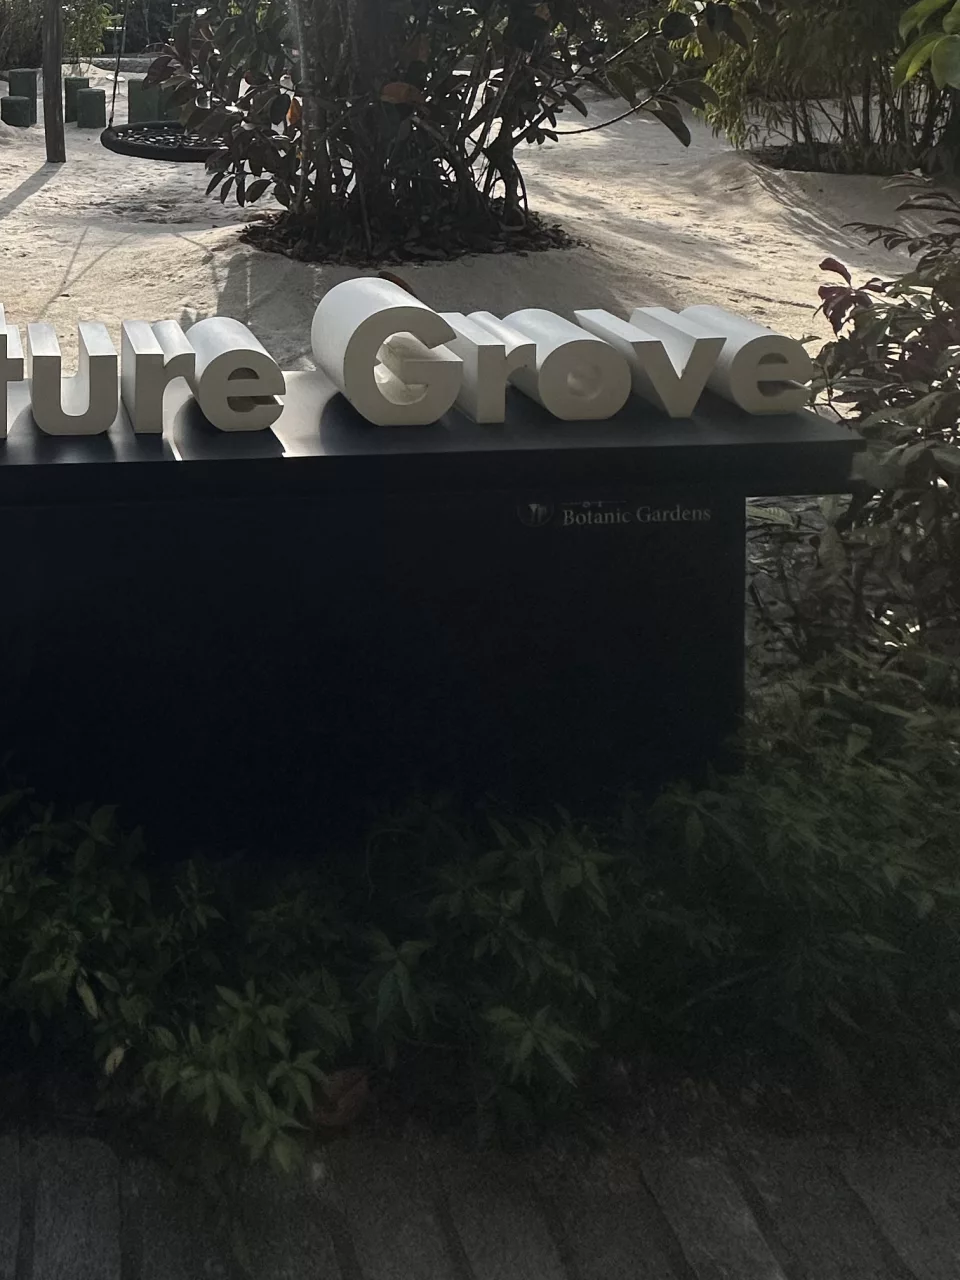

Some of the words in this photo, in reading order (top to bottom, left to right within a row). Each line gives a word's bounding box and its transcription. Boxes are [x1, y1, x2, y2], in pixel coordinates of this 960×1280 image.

[332, 294, 814, 427] Grove
[562, 507, 632, 526] Botanic
[636, 504, 712, 523] Gardens
